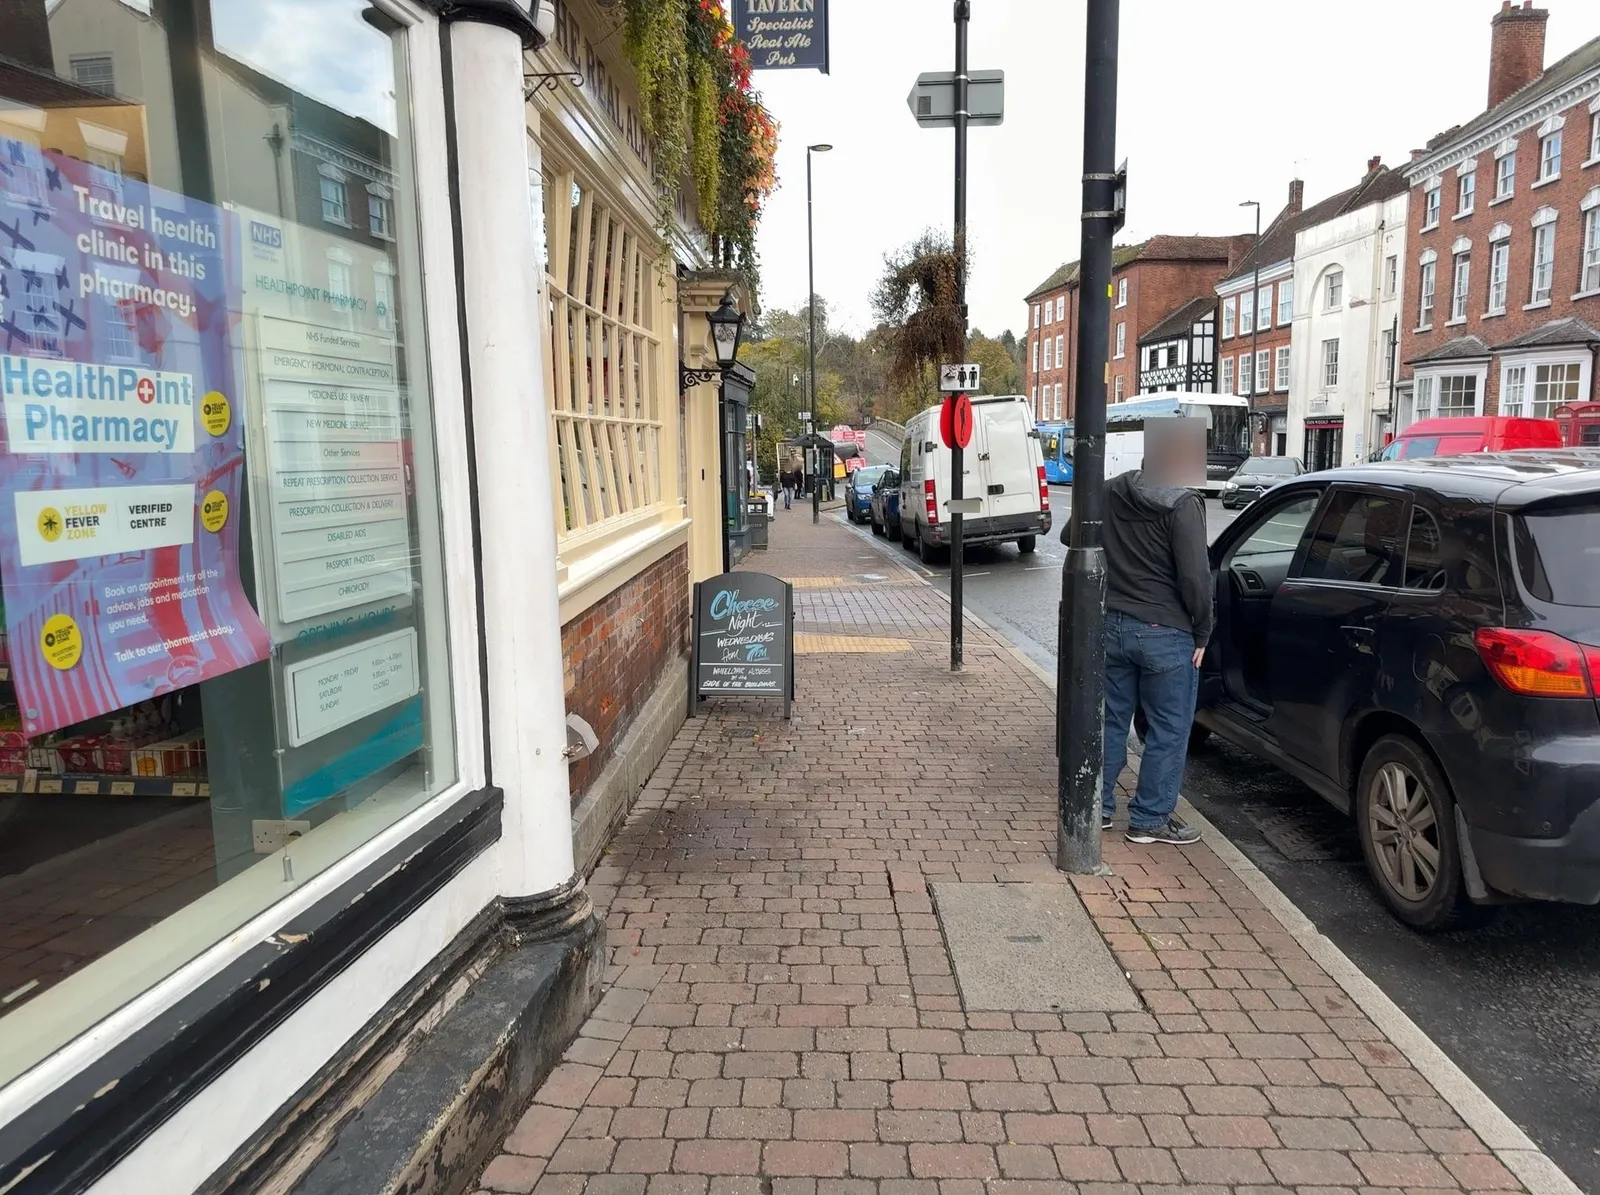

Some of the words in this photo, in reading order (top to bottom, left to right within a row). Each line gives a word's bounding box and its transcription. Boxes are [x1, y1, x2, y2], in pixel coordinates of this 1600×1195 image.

[745, 0, 814, 13] TAVERN
[747, 16, 814, 33] Specialist
[747, 34, 783, 49] Real
[784, 33, 811, 48] Ale
[766, 50, 796, 66] Pub
[584, 37, 624, 135] REAL
[626, 105, 648, 169] ALE
[73, 185, 144, 229] Travel
[152, 206, 216, 249] health
[252, 225, 280, 247] NHS
[77, 230, 139, 264] clinic
[145, 243, 163, 271] in
[169, 250, 206, 280] this
[79, 269, 197, 317] pharmacy.
[255, 275, 320, 300] HEALTHPOINT
[323, 291, 367, 311] PHARMACY
[306, 332, 319, 341] NHS
[320, 333, 339, 345] Funded
[340, 337, 360, 348] Services
[274, 356, 310, 369] EMERGENCY
[312, 361, 345, 373] HORMONAL
[346, 366, 389, 378] CONTRACEPTION
[308, 390, 337, 400] MEDICINES
[350, 392, 370, 402] REVIEW
[25, 403, 179, 449] Pharmacy
[306, 419, 321, 428] NEW
[322, 420, 348, 429] MEDICINE
[350, 421, 370, 430] SERVICE
[323, 448, 339, 457] Other
[340, 448, 360, 458] Services
[283, 477, 305, 488] REPEAT
[306, 475, 346, 486] PRESCRIPTION
[346, 474, 379, 484] COLLECTION
[380, 473, 398, 482] SERVICE
[64, 503, 107, 515] YELLOW
[129, 503, 173, 515] VERIFIED
[289, 505, 330, 517] PRESCRIPTION
[331, 502, 366, 513] COLLECTION
[372, 500, 393, 509] DELIVERY
[65, 515, 100, 528] FEVER
[130, 517, 166, 529] CENTRE
[66, 528, 96, 540] ZONE
[327, 530, 353, 542] DISABLED
[354, 529, 366, 538] AIDS
[326, 557, 352, 570] PASSPORT
[353, 554, 375, 565] PHOTOS
[104, 586, 126, 598] Book
[127, 585, 137, 594] an
[139, 577, 185, 593] appointment
[185, 573, 196, 582] for
[197, 571, 206, 580] all
[207, 568, 218, 578] the
[338, 582, 369, 596] CHIROPODY
[106, 600, 136, 614] advice,
[137, 598, 154, 611] jabs
[155, 593, 170, 604] and
[171, 585, 210, 600] medication
[710, 589, 779, 620] Cheese
[108, 620, 125, 633] you
[126, 612, 149, 626] need.
[115, 648, 135, 662] Talk
[136, 647, 146, 657] to
[147, 643, 161, 654] our
[163, 630, 208, 650] pharmacist
[209, 624, 235, 637] today.
[717, 632, 774, 648] WEDNESDAYS
[318, 673, 340, 686] MONDAY
[344, 667, 359, 678] FRIDAY
[319, 684, 343, 699] SATURDAY
[320, 699, 339, 712] SUNDAY
